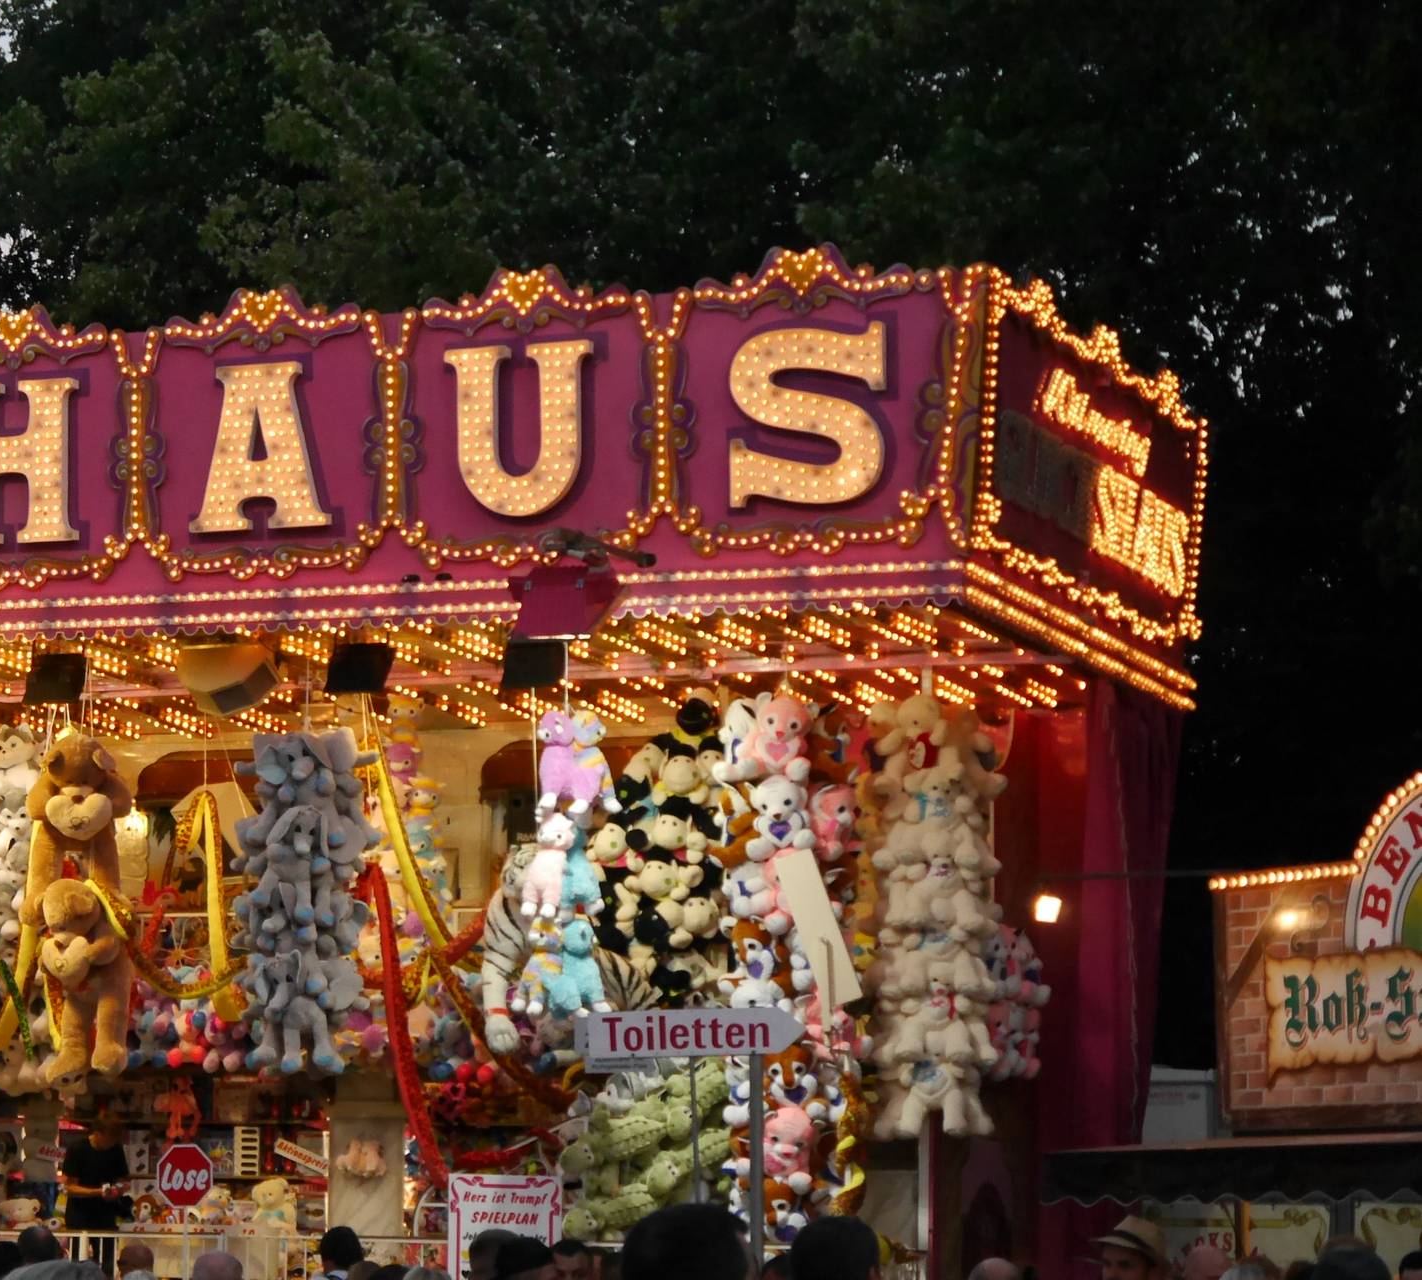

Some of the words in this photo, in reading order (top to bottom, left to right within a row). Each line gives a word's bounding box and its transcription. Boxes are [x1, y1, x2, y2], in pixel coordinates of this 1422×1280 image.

[602, 1016, 770, 1052] Toiletten
[161, 1162, 209, 1191] Lose
[463, 1191, 487, 1203] Herz
[492, 1192, 506, 1204] ist
[511, 1192, 548, 1206] Trumpf
[471, 1211, 538, 1225] SPIELPLAN
